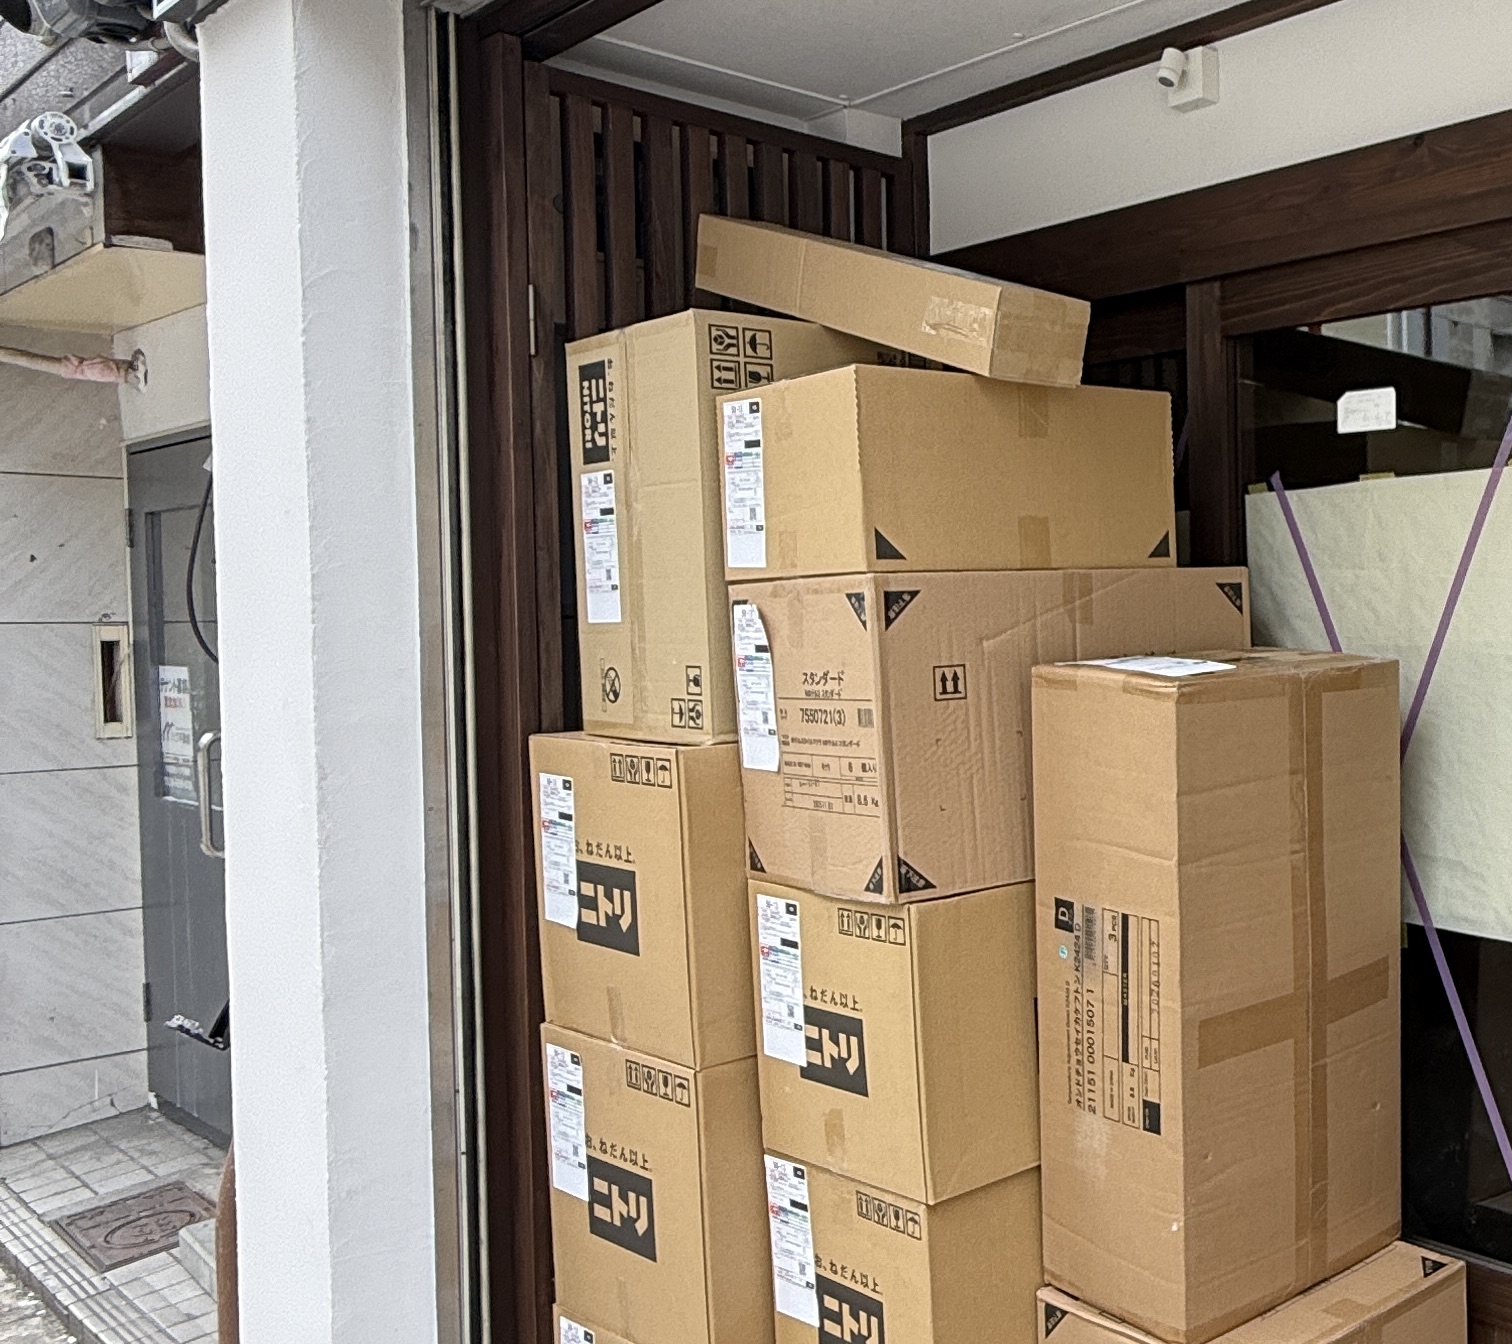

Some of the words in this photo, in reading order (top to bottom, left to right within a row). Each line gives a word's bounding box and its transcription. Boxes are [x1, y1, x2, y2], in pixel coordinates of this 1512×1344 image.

[582, 380, 593, 449] NITORI
[591, 378, 607, 448] ニトリ
[802, 669, 845, 687] スタンダード
[799, 707, 846, 727] 7550721(3)
[579, 880, 633, 934] ニトリ
[1108, 933, 1118, 942] 3
[804, 1023, 860, 1076] ニトリ
[1086, 999, 1096, 1065] 0001507
[1086, 1069, 1096, 1115] 21151
[592, 1175, 649, 1238] ニトリ
